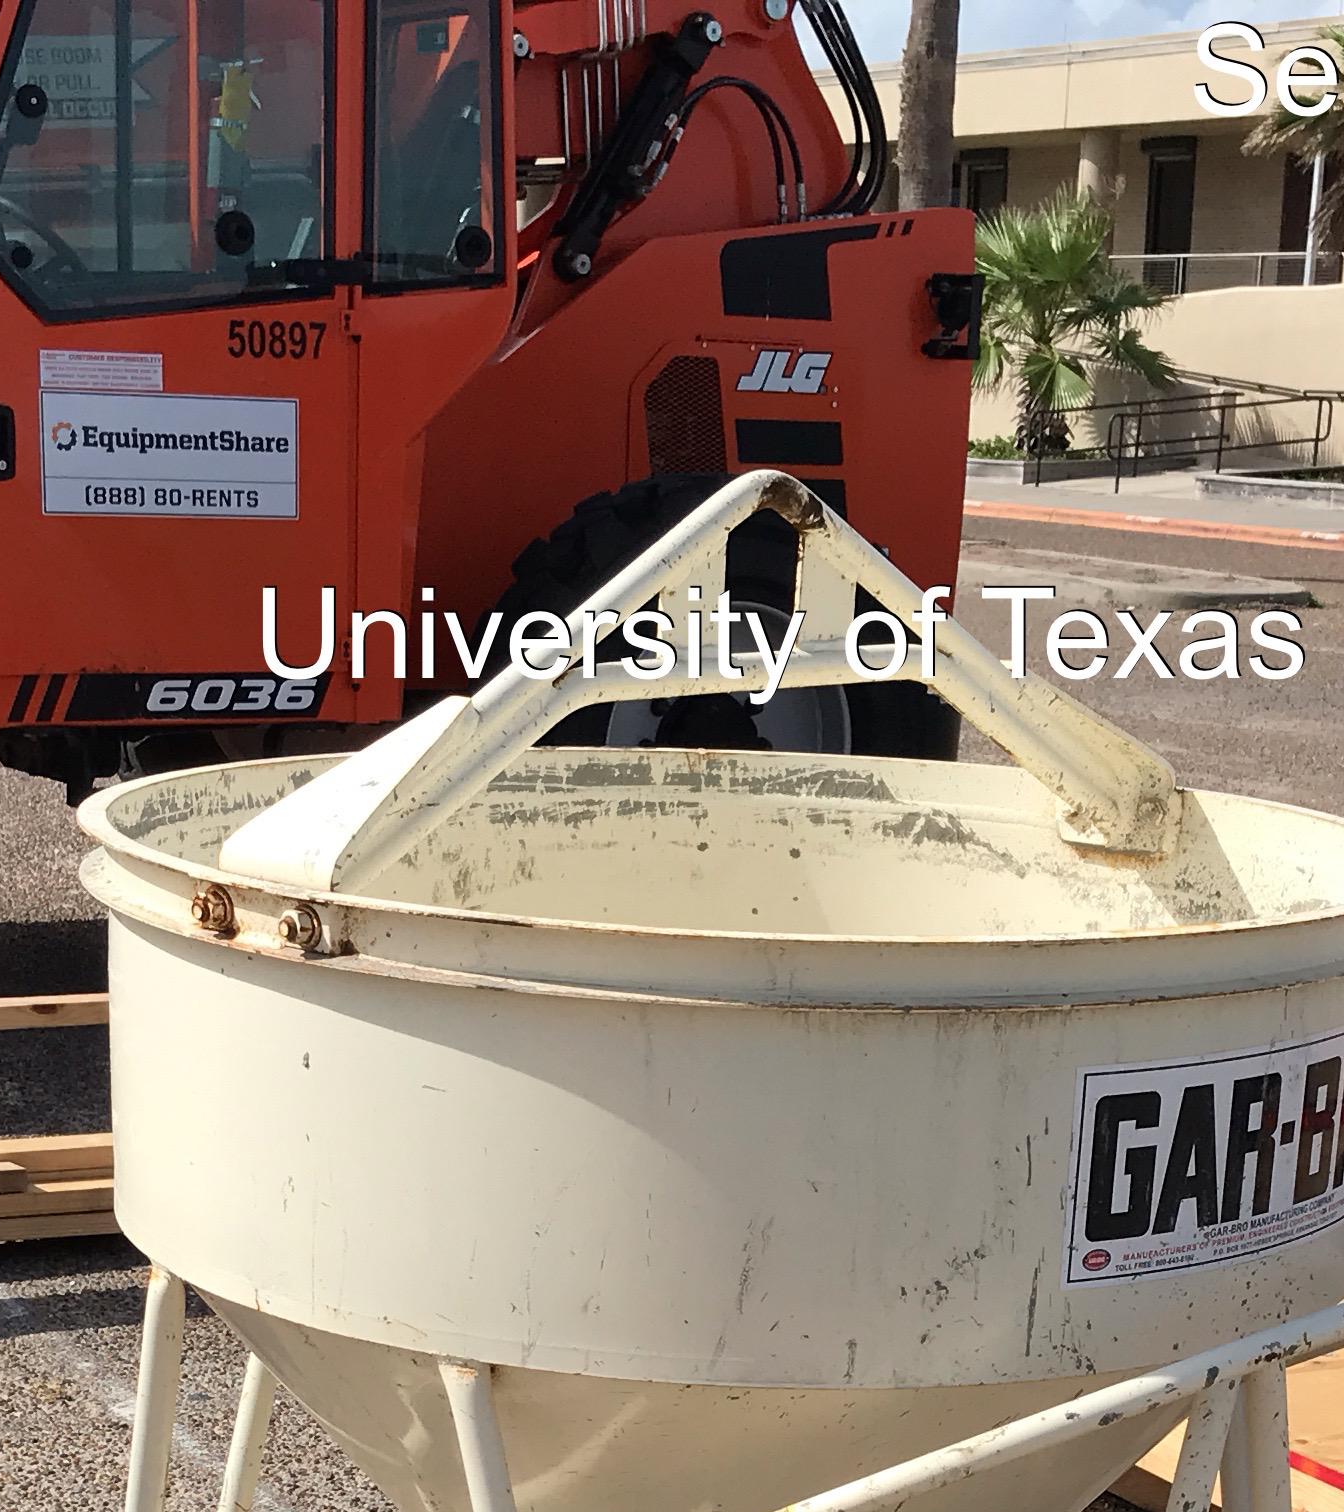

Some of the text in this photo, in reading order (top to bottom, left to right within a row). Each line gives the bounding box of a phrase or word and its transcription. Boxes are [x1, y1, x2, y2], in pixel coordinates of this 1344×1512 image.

[227, 320, 327, 359] 50897
[735, 349, 834, 395] JLG
[82, 425, 290, 454] EquipmentShare
[85, 485, 260, 508] (888) 80-RENTS
[146, 678, 318, 712] 6036
[1122, 1243, 1197, 1262] MANUFACTURERS
